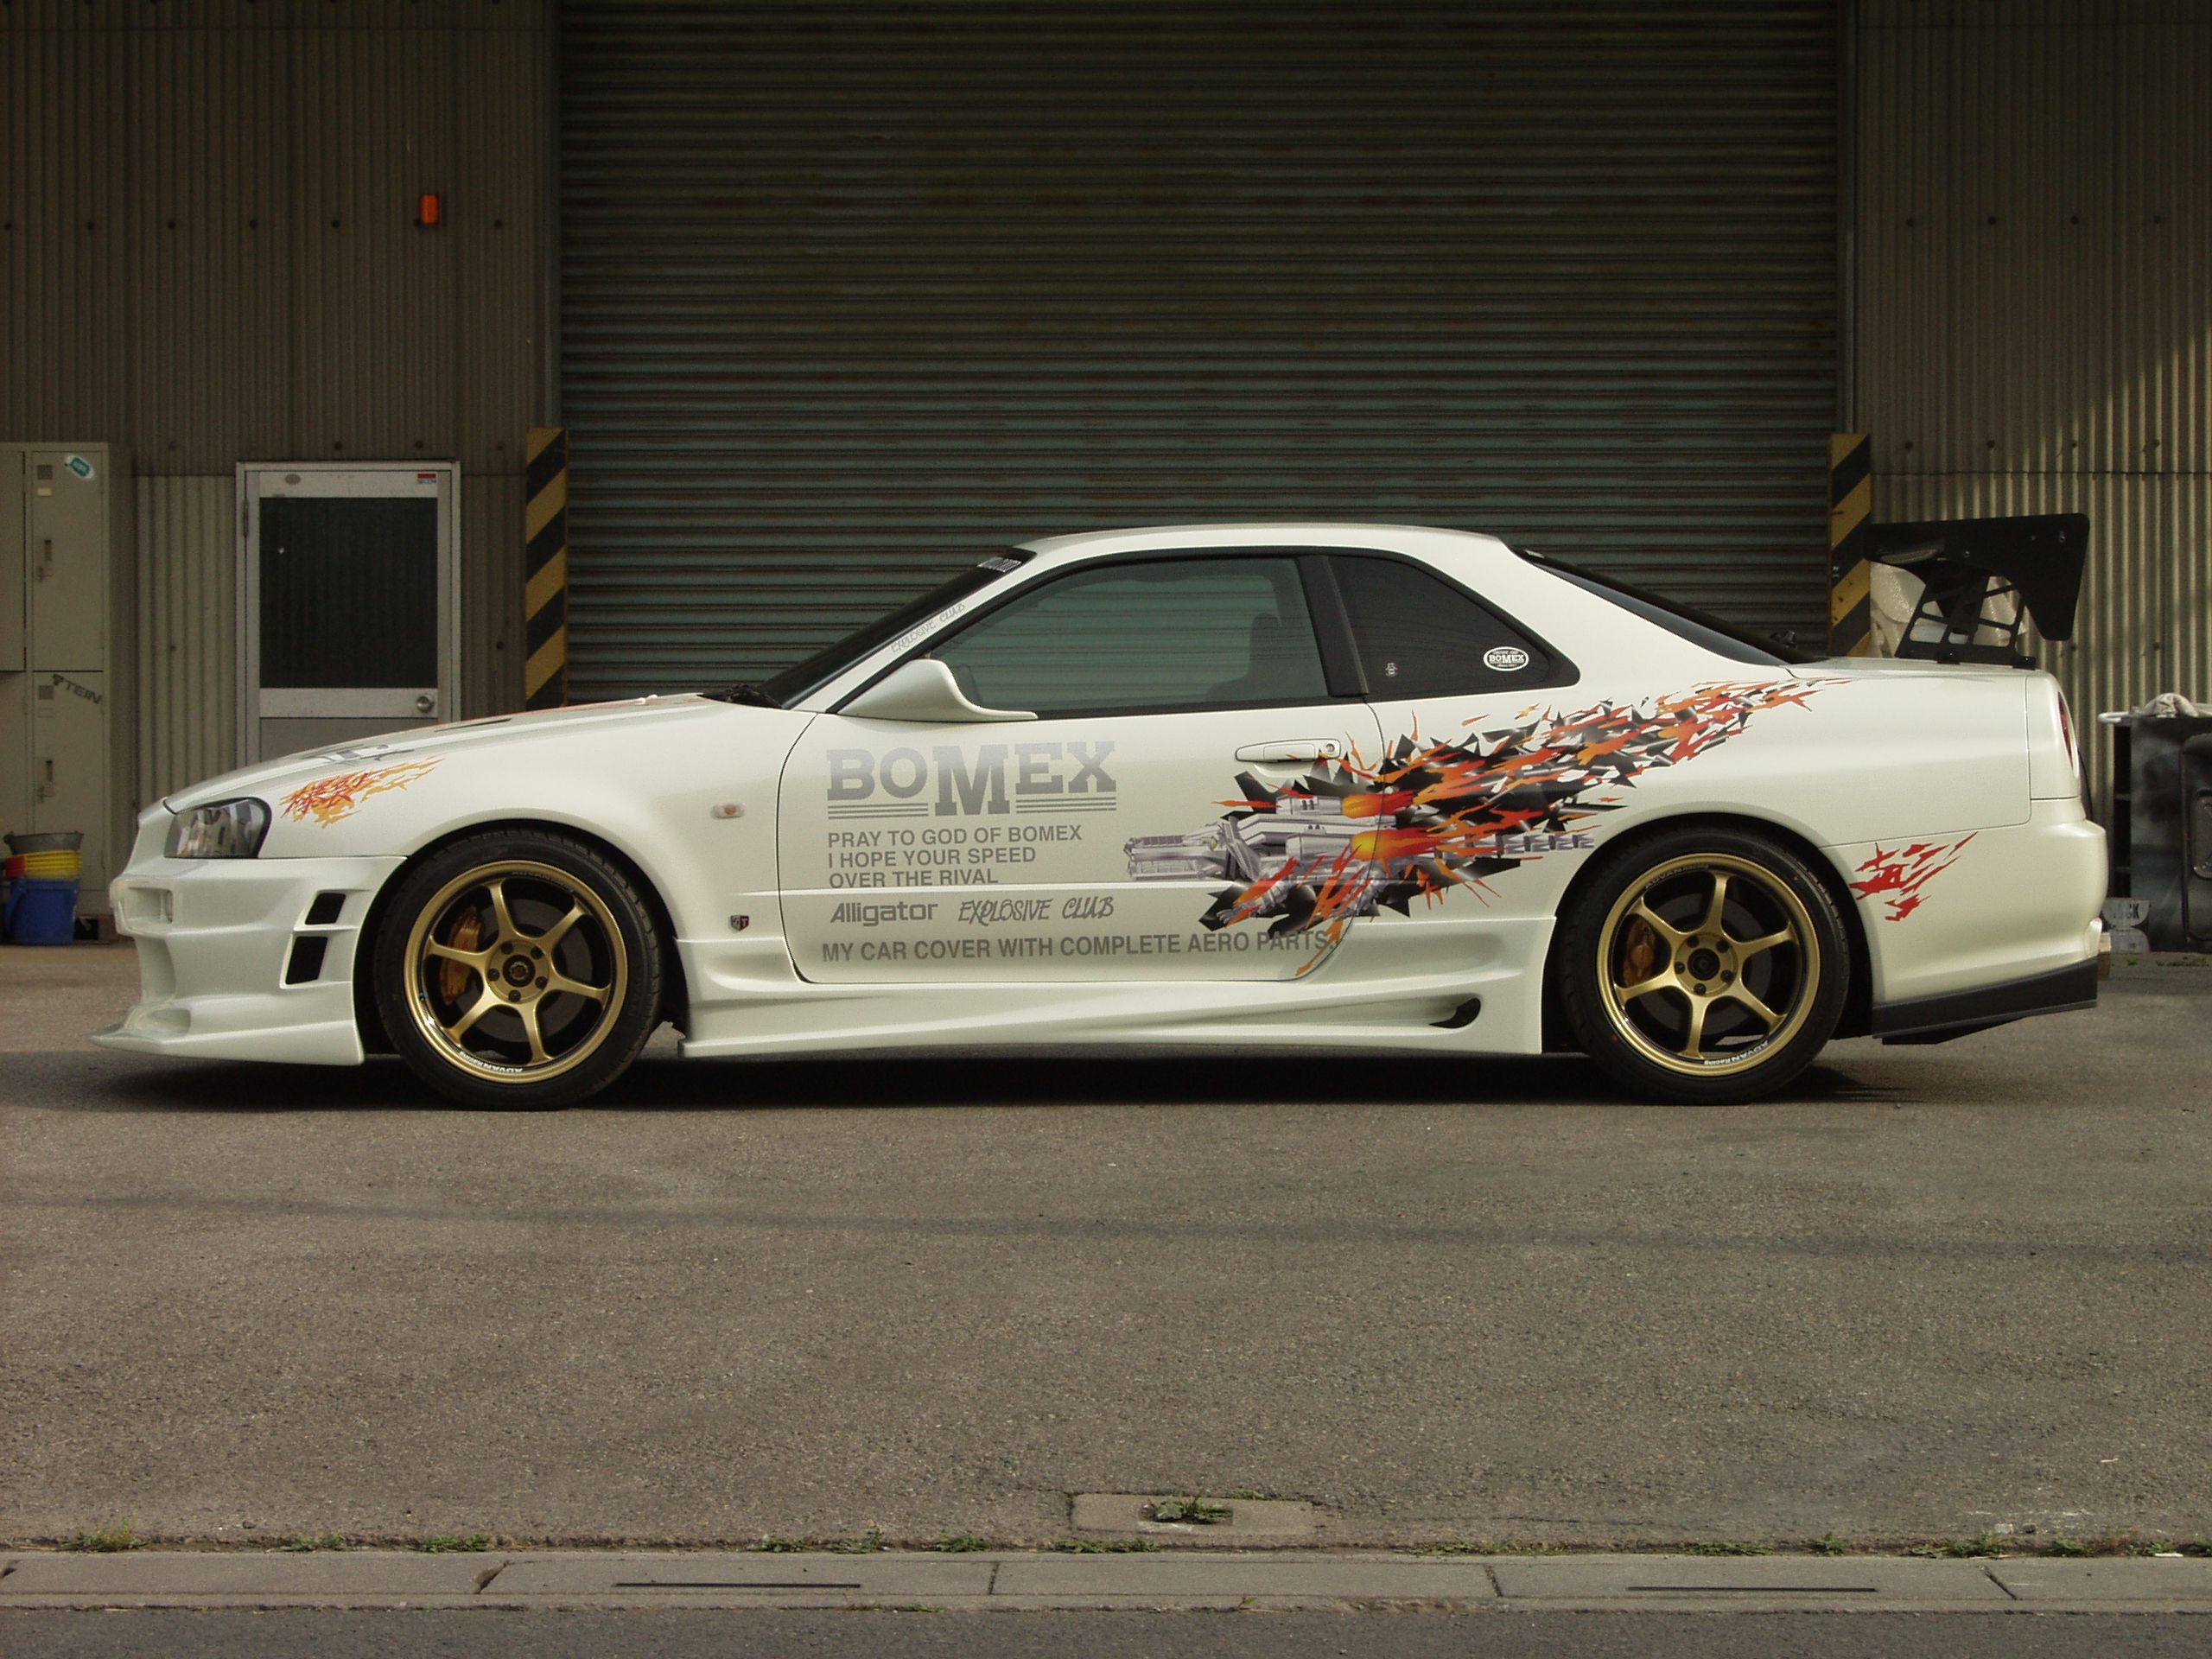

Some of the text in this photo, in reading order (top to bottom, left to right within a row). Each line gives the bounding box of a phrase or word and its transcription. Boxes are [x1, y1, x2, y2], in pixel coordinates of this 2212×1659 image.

[938, 603, 966, 622] CLUB
[1489, 654, 1524, 664] BOMEX
[826, 741, 1116, 816] BOMEX
[828, 824, 1083, 848] PRAY TO GOD OF BOMEX
[828, 847, 1036, 868] I HOPE YOUR SPEED
[829, 868, 998, 888] OVER THE RIVAL
[830, 901, 938, 926] Alligator
[958, 896, 1114, 926] EXPLOSIVE CLUB
[823, 943, 854, 962] MY
[861, 941, 906, 960] CAR
[914, 939, 990, 959] COVER
[998, 938, 1052, 957] WITH
[1060, 934, 1180, 956] COMPLETE
[1187, 932, 1249, 952] AERO
[1732, 1039, 1769, 1062] ADVAN
[484, 1062, 524, 1073] ADVAN
